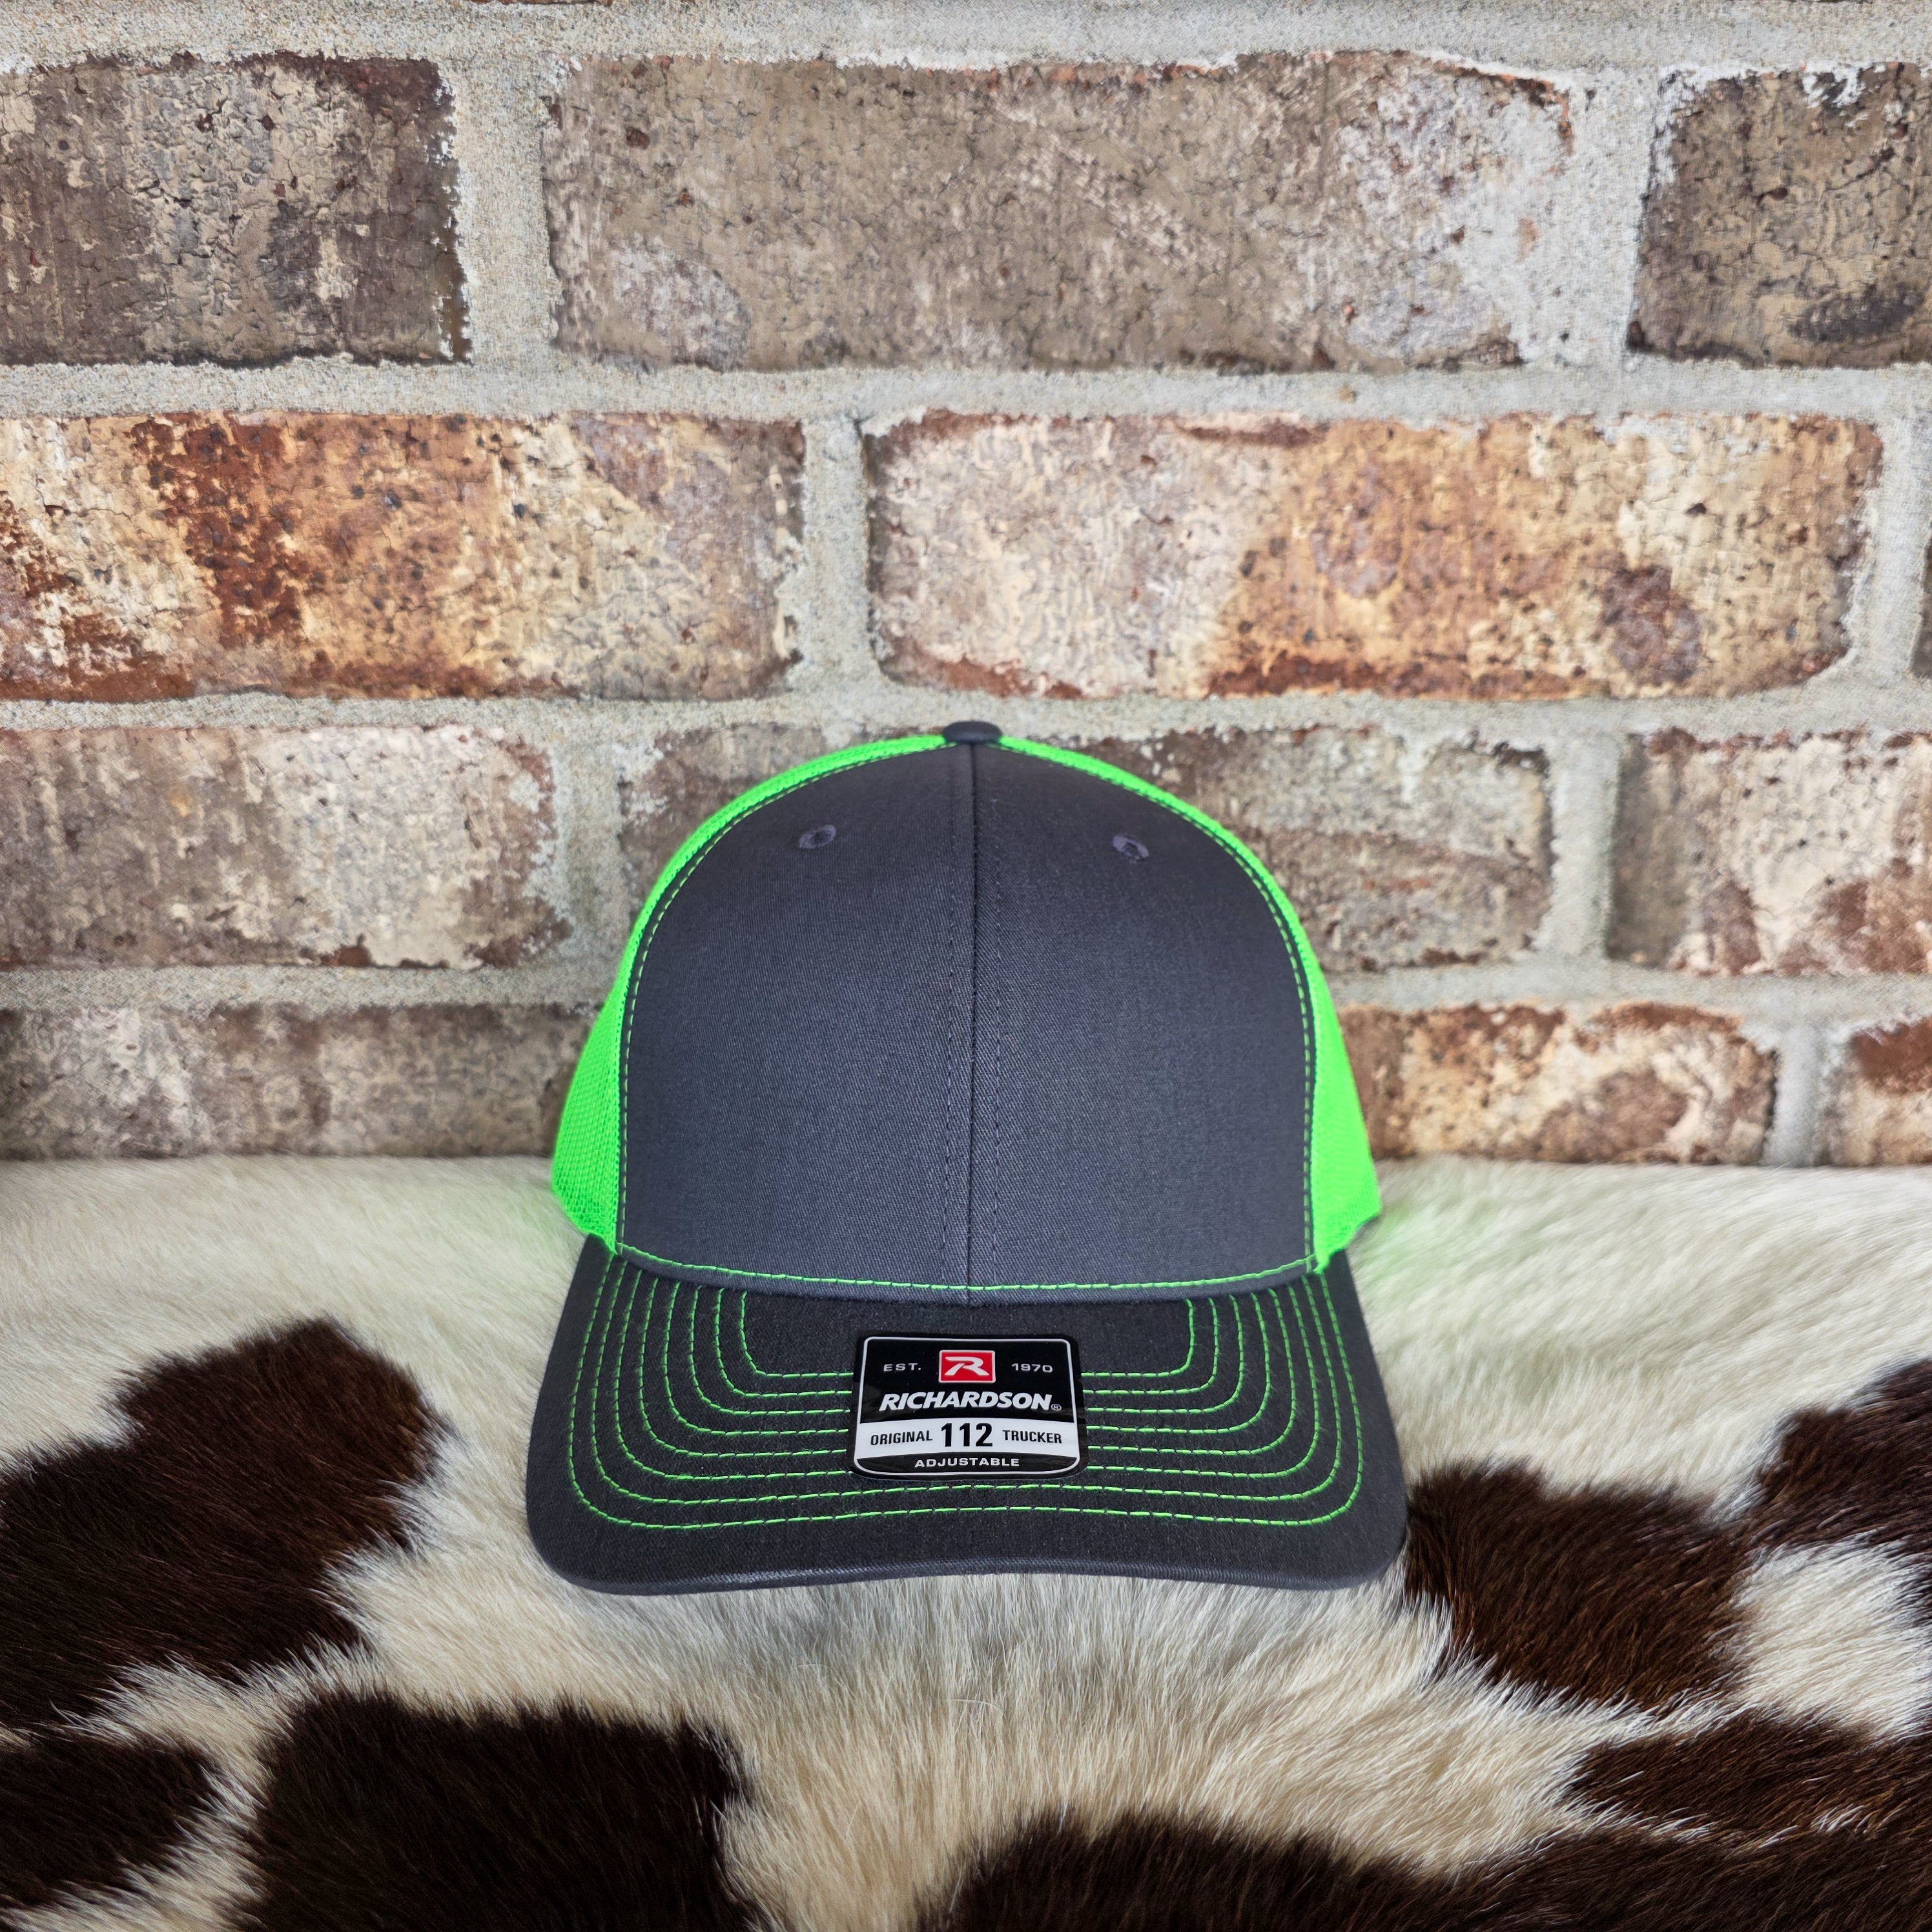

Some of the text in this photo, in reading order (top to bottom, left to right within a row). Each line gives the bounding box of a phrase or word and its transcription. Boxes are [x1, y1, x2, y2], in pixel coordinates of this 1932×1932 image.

[883, 1362, 921, 1372] EST.
[1011, 1362, 1053, 1373] 1970
[870, 1423, 1062, 1447] ORIGINAL 112 TRUCKER
[914, 1457, 1020, 1468] ADJUSTABLE
